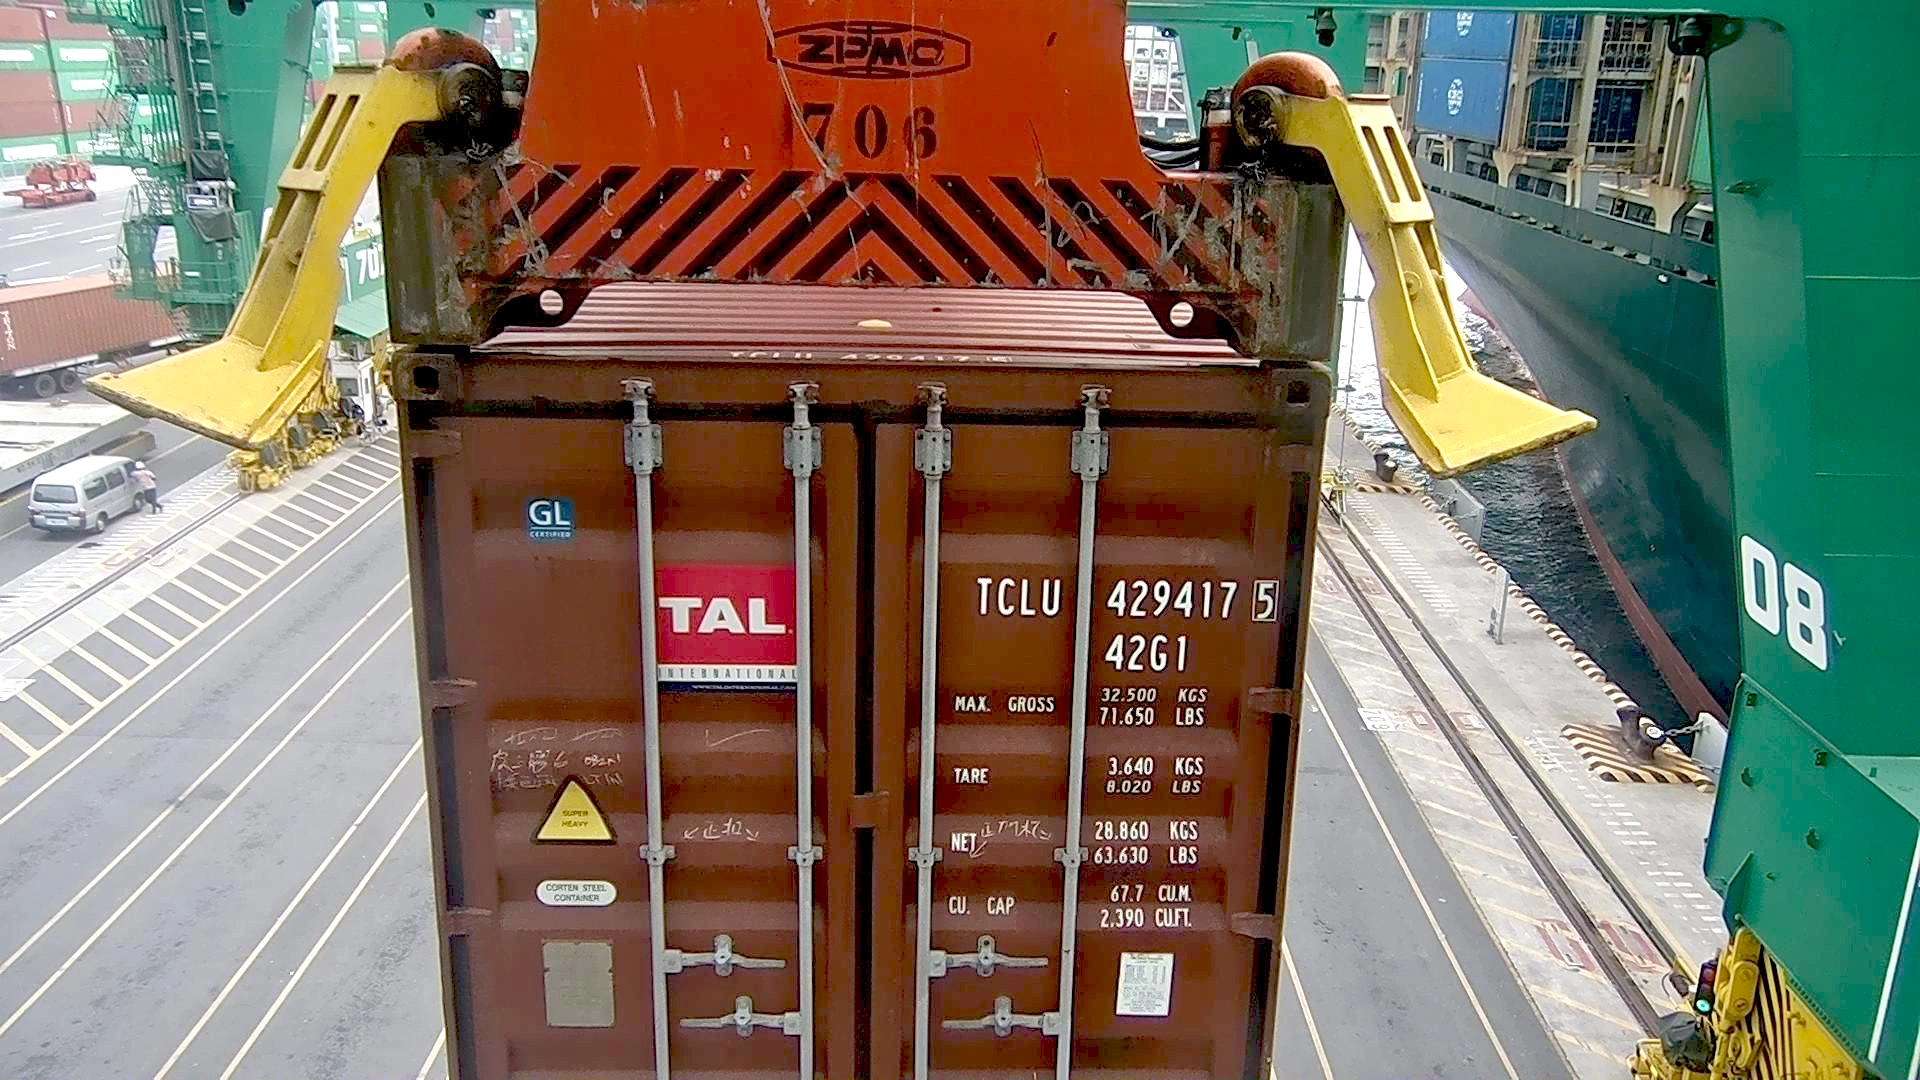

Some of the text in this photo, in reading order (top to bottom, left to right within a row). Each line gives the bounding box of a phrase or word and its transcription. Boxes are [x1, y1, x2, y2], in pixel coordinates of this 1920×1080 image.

[797, 33, 945, 67] ZPMC
[801, 102, 938, 160] 706
[528, 499, 571, 526] GL
[976, 577, 1277, 620] TCLU 429417 5
[1740, 534, 1828, 672] 08
[658, 596, 788, 634] TAL
[1104, 634, 1188, 671] 42G1
[658, 668, 799, 679] INTERNATIONAL
[955, 687, 1208, 713] MAX. GROSS 32.500 KGS
[1099, 706, 1205, 726] 71.650 LBS
[954, 756, 1204, 784] TARE 3.640 KGS
[1106, 779, 1202, 794] 8.020 LBS
[951, 820, 1199, 852] NET 28.860 KGS
[1093, 845, 1199, 864] 63.630 LBS
[545, 883, 607, 892] CORTEN STEEL
[553, 894, 600, 902] CONTAINER
[948, 895, 971, 915] CU.
[987, 896, 1015, 915] CAP
[1110, 884, 1145, 902] 67.7
[1100, 908, 1145, 928] 2.390
